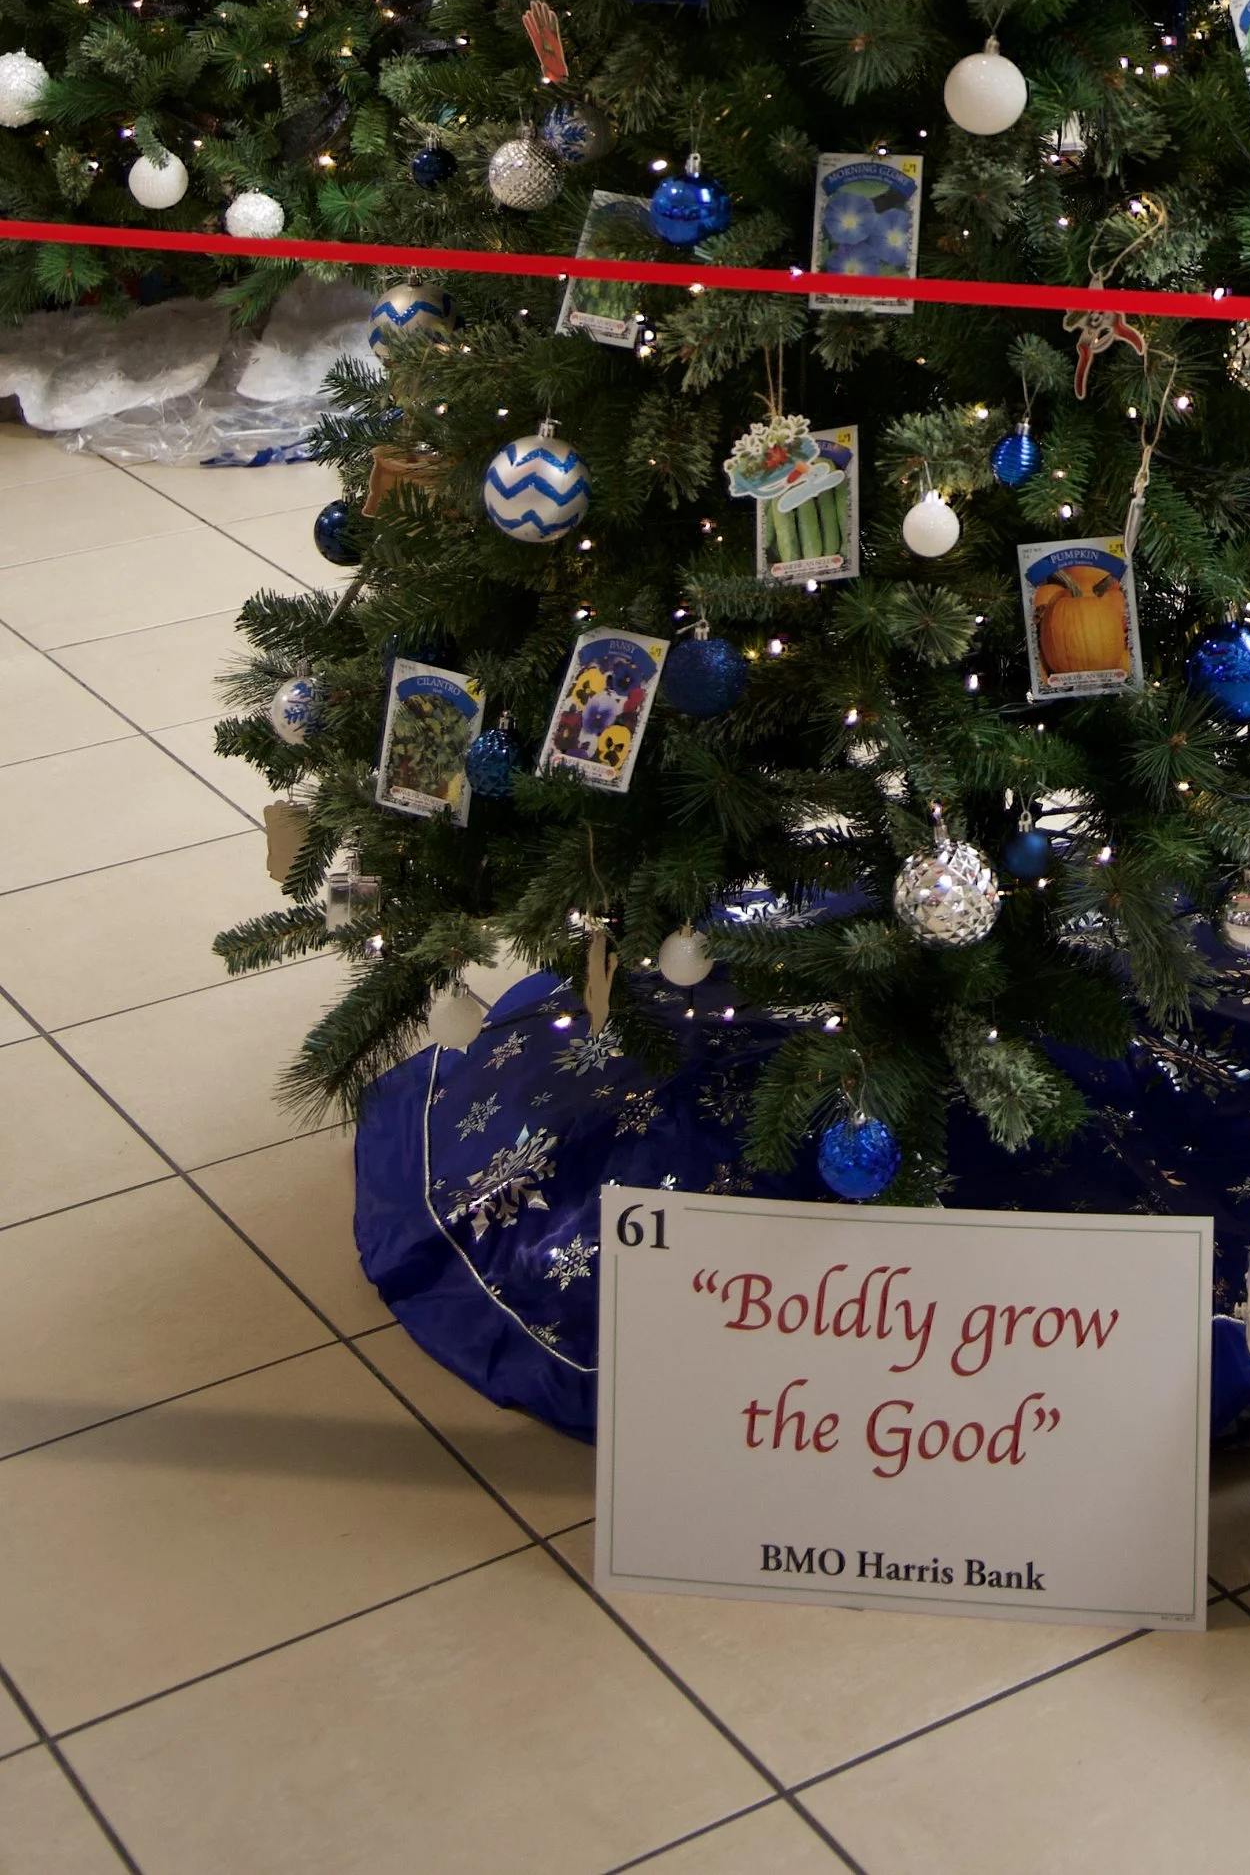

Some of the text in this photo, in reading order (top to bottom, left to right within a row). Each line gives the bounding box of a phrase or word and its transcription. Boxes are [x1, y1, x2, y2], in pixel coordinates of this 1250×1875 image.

[828, 163, 878, 184] MORNING
[879, 166, 909, 186] GLORY
[1050, 549, 1100, 564] PUMPKIN
[609, 639, 637, 654] PANSY
[416, 677, 461, 696] CILANTRO
[615, 1203, 670, 1251] 61
[692, 1264, 1120, 1377] “Boldly grow
[740, 1379, 1062, 1479] the Good”
[759, 1543, 1047, 1592] BMO Harris Bank
